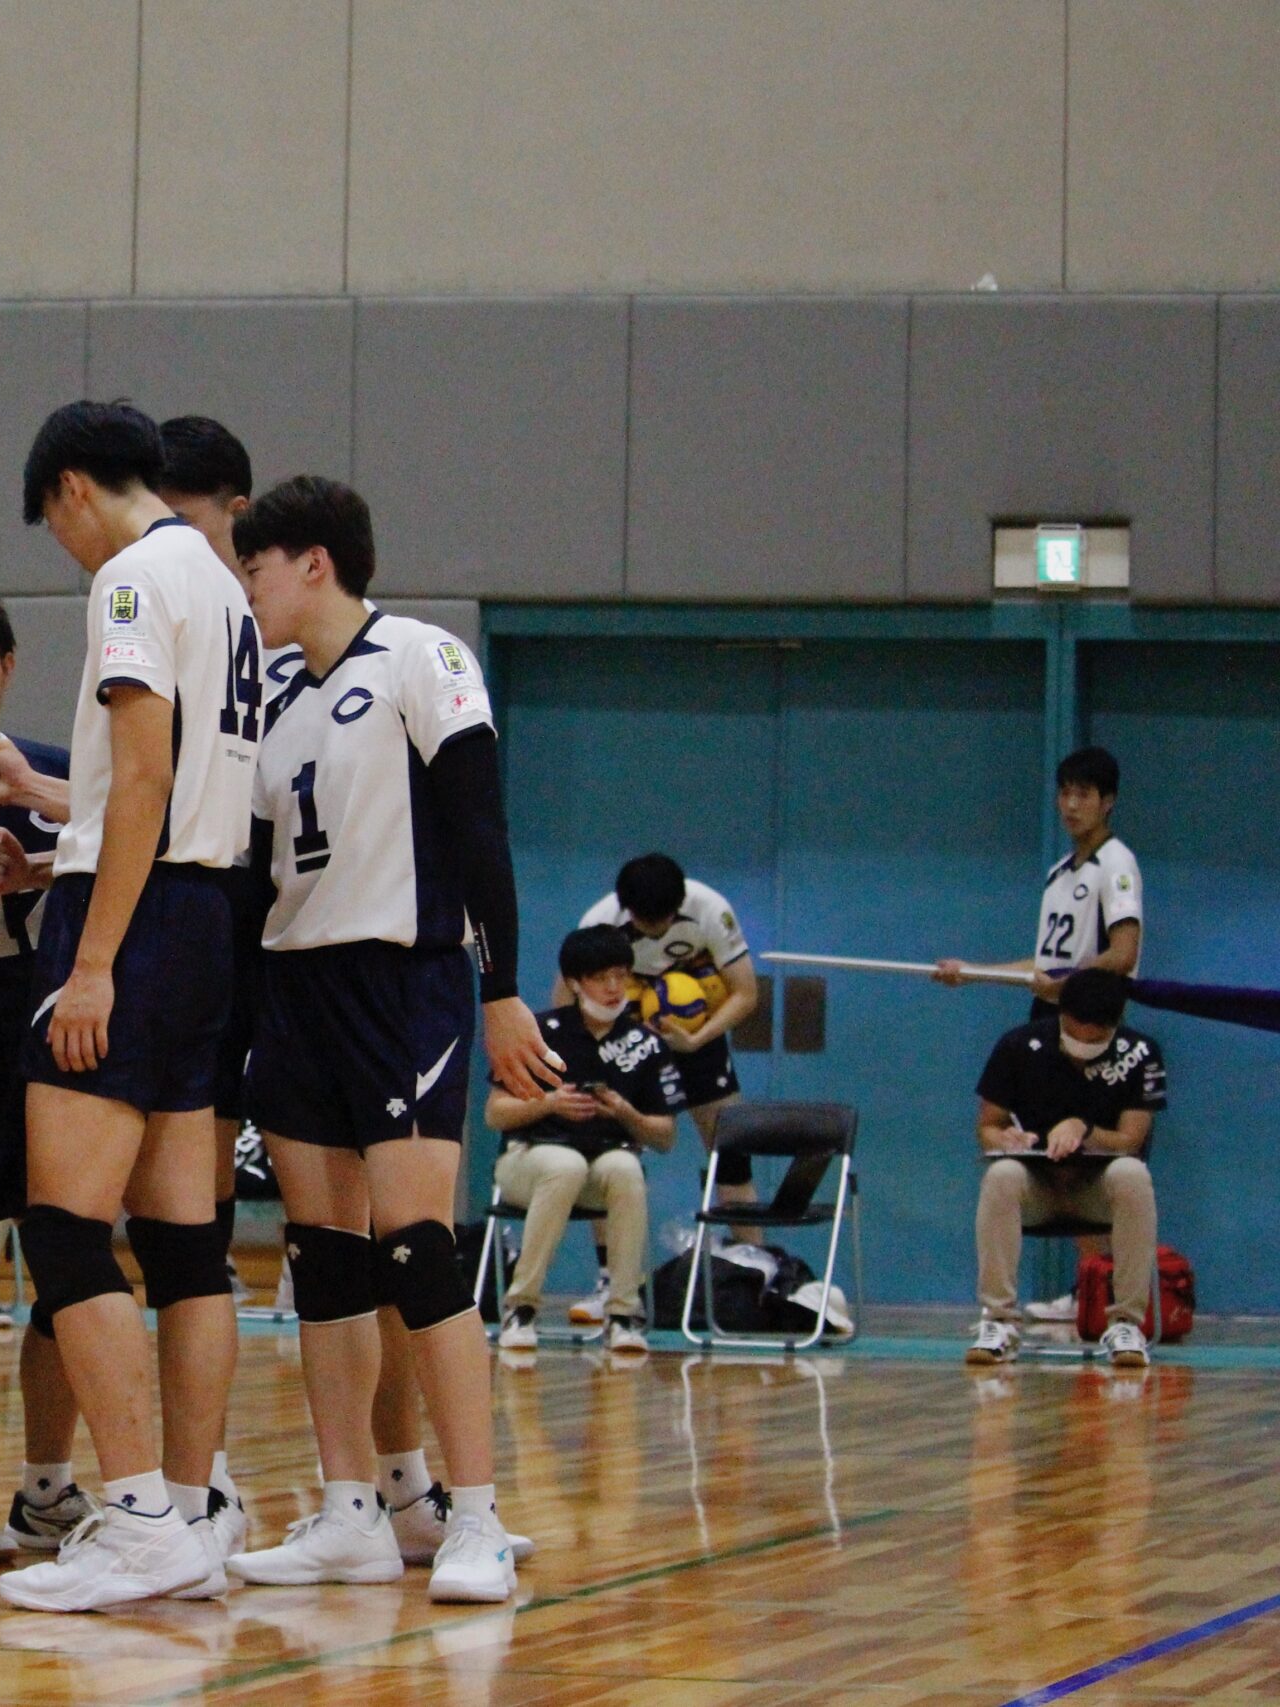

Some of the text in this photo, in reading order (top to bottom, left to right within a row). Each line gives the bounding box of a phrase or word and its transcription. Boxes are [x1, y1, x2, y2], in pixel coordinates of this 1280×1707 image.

[219, 605, 263, 743] 14
[291, 759, 330, 856] 1
[1040, 912, 1075, 960] 22
